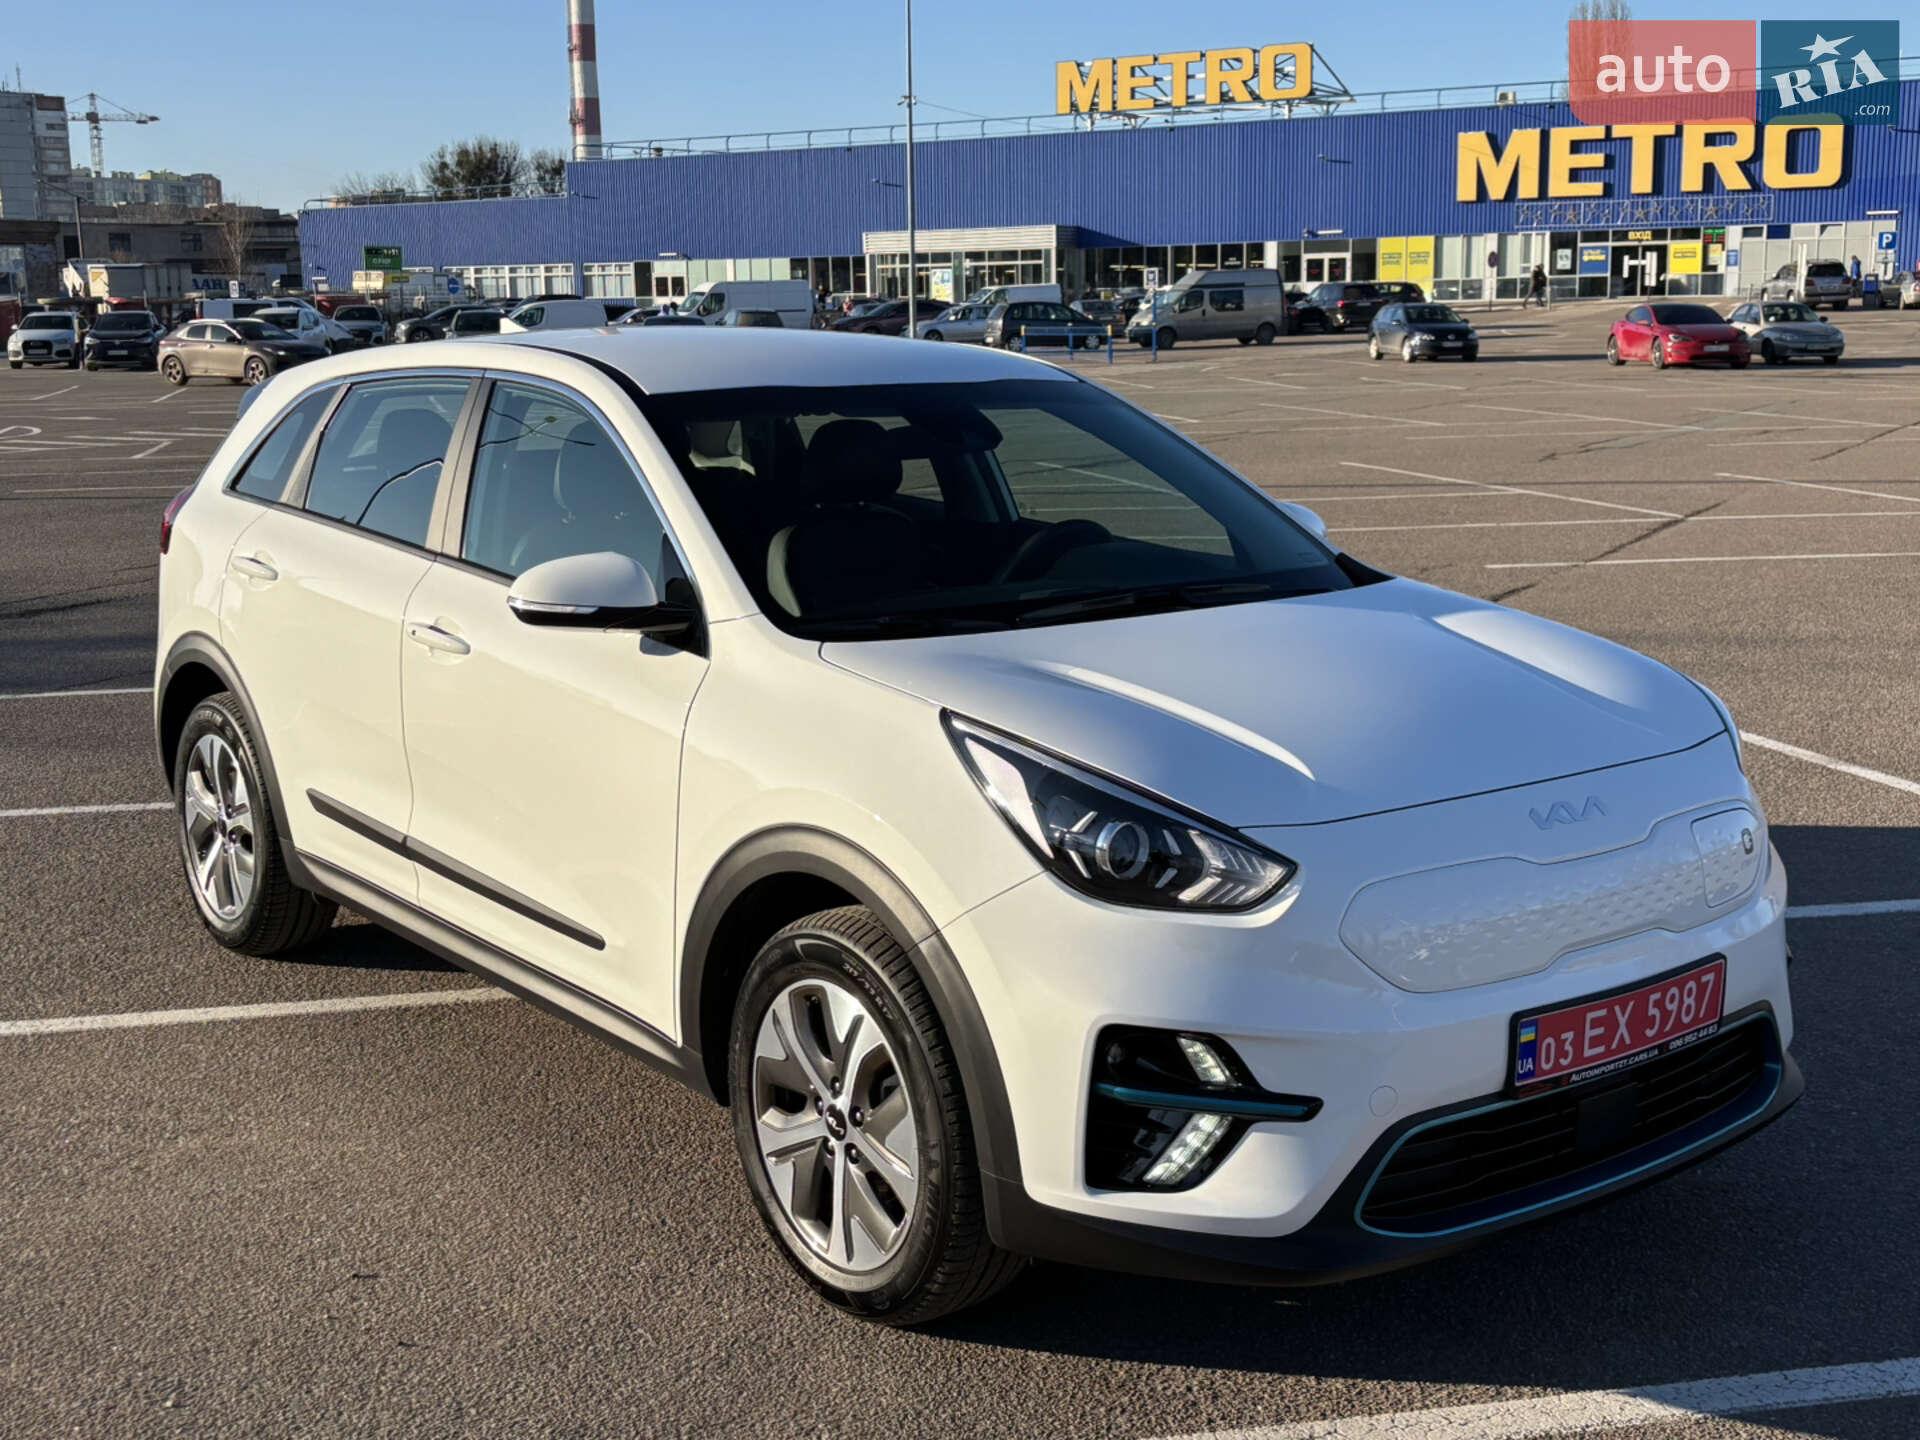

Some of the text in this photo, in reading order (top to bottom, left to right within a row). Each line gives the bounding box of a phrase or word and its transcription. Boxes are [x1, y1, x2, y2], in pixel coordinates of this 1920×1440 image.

[1056, 42, 1312, 115] METRO
[1457, 113, 1844, 203] METRO
[1882, 233, 1893, 249] P
[1540, 972, 1715, 1070] 03 EX 5987
[1518, 1057, 1534, 1075] UA
